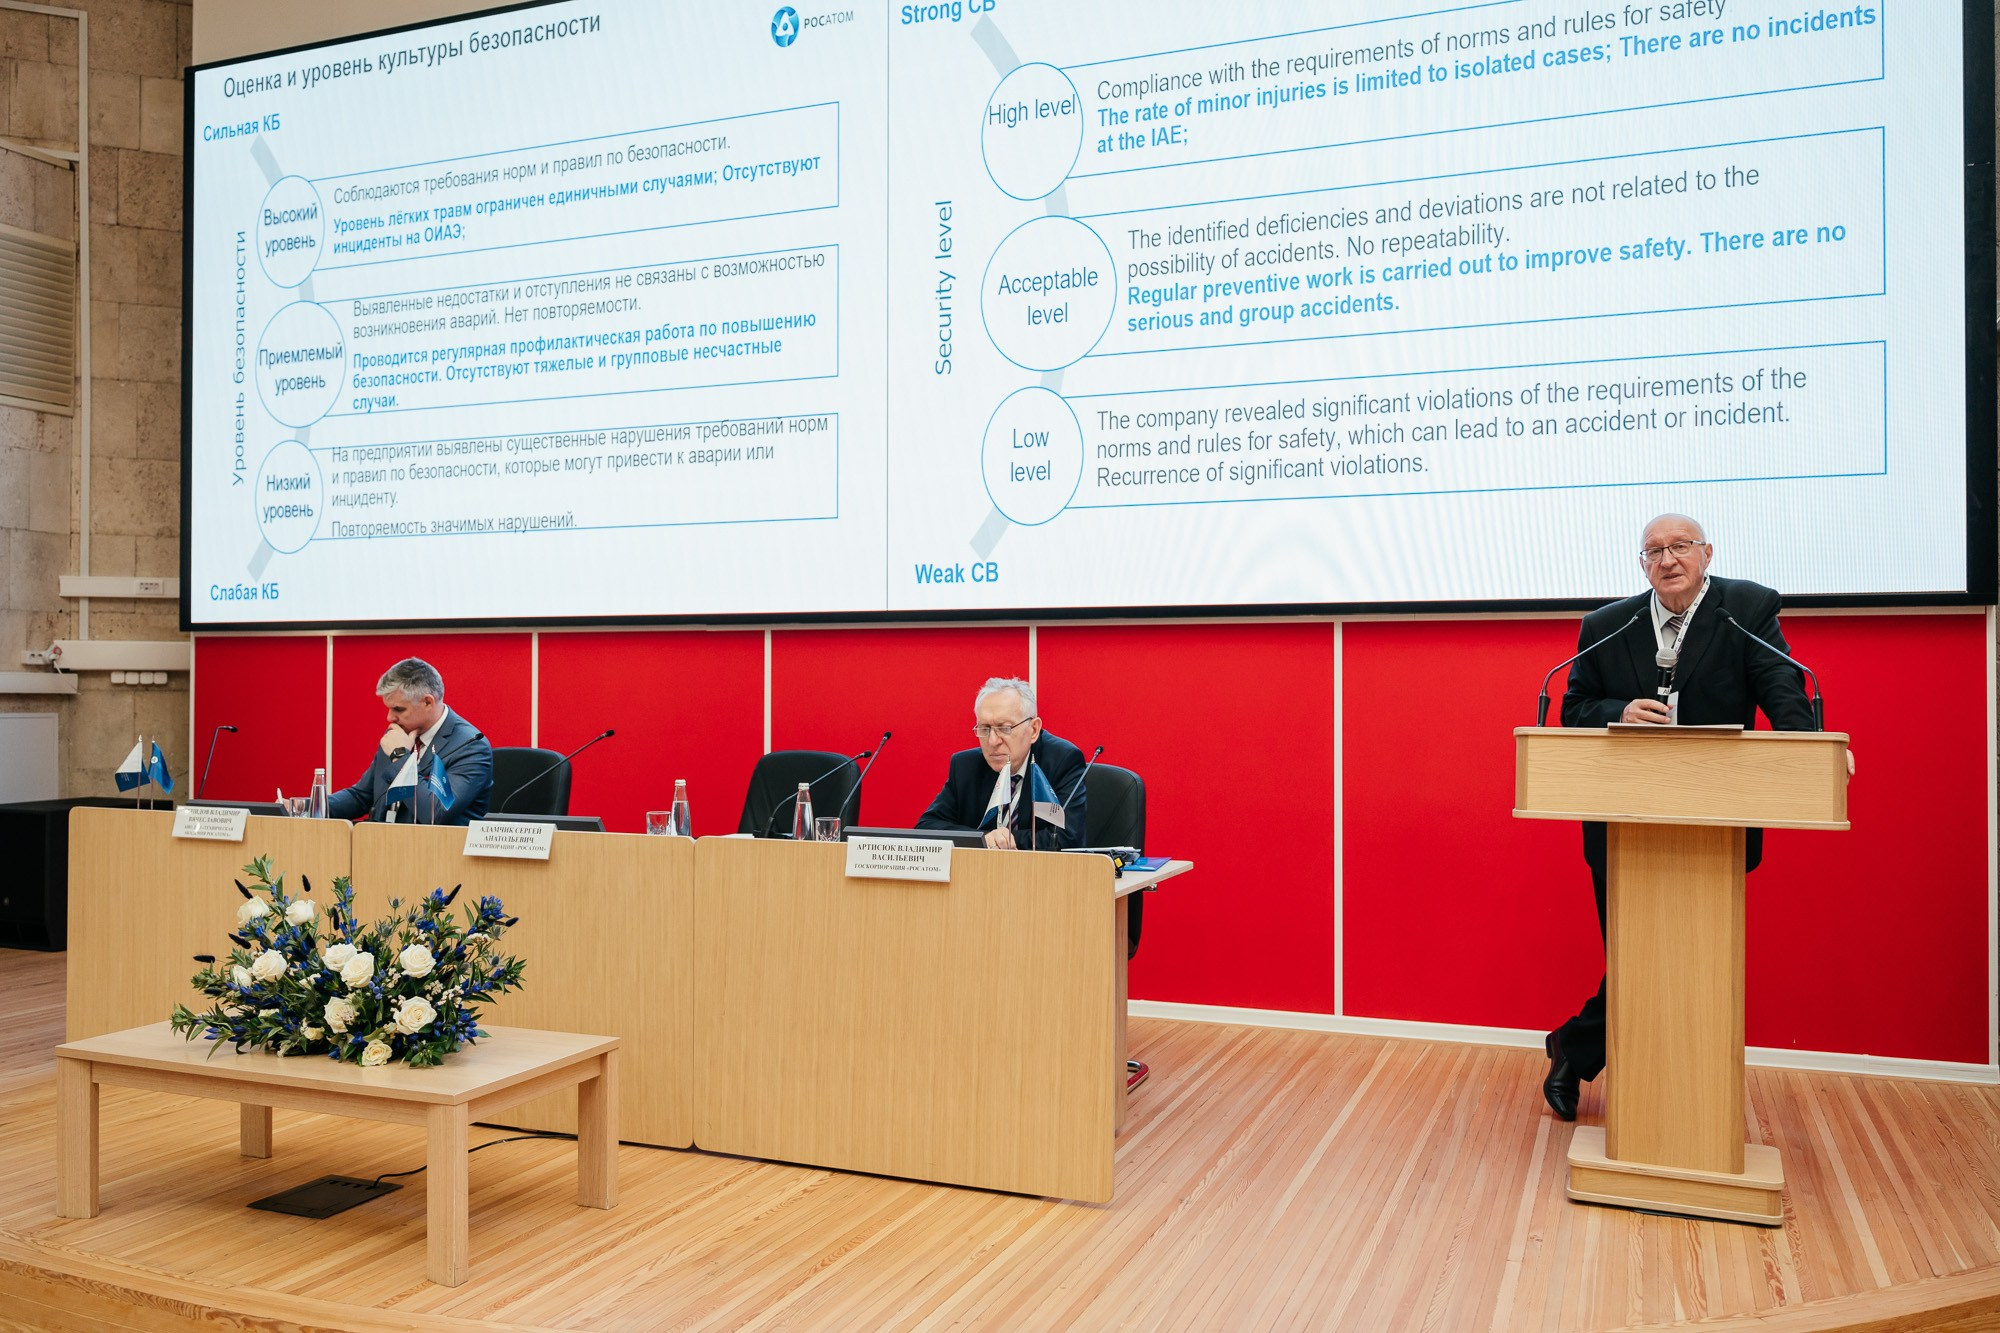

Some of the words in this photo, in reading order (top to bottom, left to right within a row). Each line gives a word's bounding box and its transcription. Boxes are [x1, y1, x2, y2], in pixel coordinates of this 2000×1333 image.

[803, 11, 854, 29] РОСАТОМ
[901, 1, 962, 25] Strong
[968, 0, 996, 14] CB
[223, 73, 282, 98] Оценка
[287, 70, 296, 87] и
[302, 58, 373, 90] уровень
[379, 40, 463, 75] культуры
[469, 15, 600, 54] безопасности
[1097, 72, 1203, 100] Compliance
[1208, 61, 1245, 85] with
[1251, 58, 1280, 79] the
[1287, 39, 1414, 76] requirements
[1421, 31, 1441, 55] of
[1447, 28, 1510, 52] norms
[1517, 15, 1556, 42] and
[1564, 10, 1616, 35] rules
[1623, 4, 1653, 27] for
[1659, 0, 1726, 22] safety
[1097, 107, 1129, 127] The
[1135, 102, 1168, 122] rate
[1174, 96, 1192, 117] of
[1197, 93, 1251, 114] minor
[1257, 81, 1327, 109] injuries
[1333, 76, 1349, 96] is
[1356, 65, 1422, 93] limited
[1428, 64, 1448, 83] to
[1454, 49, 1535, 80] isolated
[1542, 44, 1611, 67] cases;
[1619, 34, 1682, 57] There
[1689, 28, 1724, 48] are
[1732, 24, 1761, 43] no
[1768, 5, 1876, 38] incidents
[988, 101, 1028, 129] High
[1035, 93, 1076, 118] level
[203, 120, 259, 142] Сильная
[263, 113, 281, 132] КБ
[1097, 134, 1114, 154] at
[1118, 131, 1146, 151] the
[1151, 124, 1188, 147] IAE;
[333, 217, 385, 235] Уровень
[388, 210, 429, 226] лёгких
[433, 204, 472, 223] травм
[475, 194, 545, 217] ограничен
[548, 181, 638, 206] единичными
[642, 170, 717, 194] случаями;
[722, 156, 821, 183] Отсутствуют
[1128, 229, 1162, 250] The
[1168, 217, 1249, 246] identified
[1256, 207, 1369, 237] deficiencies
[1375, 200, 1411, 224] and
[1419, 192, 1523, 220] deviations
[1530, 189, 1564, 208] are
[1572, 180, 1605, 204] not
[1612, 171, 1687, 200] related
[1695, 170, 1716, 191] to
[1724, 166, 1760, 188] the
[264, 202, 318, 227] Высокий
[935, 200, 952, 259] level
[265, 235, 316, 257] уровень
[333, 234, 402, 254] инциденты
[406, 232, 420, 245] на
[424, 223, 465, 243] ОИАЭ;
[1128, 251, 1215, 284] possibility
[1221, 247, 1239, 269] of
[1244, 240, 1339, 267] accidents.
[1347, 235, 1375, 257] No
[1381, 223, 1510, 258] repeatability.
[998, 266, 1099, 297] Acceptable
[1128, 282, 1198, 308] Regular
[1203, 273, 1300, 303] preventive
[1306, 266, 1353, 289] work
[1360, 265, 1375, 285] is
[1382, 256, 1452, 282] carried
[1459, 253, 1492, 275] out
[1497, 252, 1519, 272] to
[1525, 246, 1612, 272] improve
[1619, 236, 1692, 261] safety.
[1701, 231, 1765, 253] There
[1772, 228, 1808, 247] are
[1817, 225, 1846, 243] no
[232, 231, 246, 384] безопасности
[1027, 302, 1068, 326] level
[1127, 311, 1194, 332] serious
[1199, 305, 1233, 327] and
[1239, 304, 1295, 328] group
[1300, 292, 1399, 318] accidents.
[935, 271, 957, 375] Security
[259, 342, 343, 369] Приемлемый
[353, 350, 428, 372] Проводится
[431, 343, 506, 365] регулярная
[510, 330, 641, 357] профилактическая
[645, 323, 695, 346] работа
[699, 323, 717, 337] по
[721, 313, 817, 335] повышению
[353, 370, 441, 389] безопасности.
[446, 362, 530, 383] Отсутствуют
[533, 356, 594, 373] тяжелые
[598, 355, 607, 368] и
[611, 348, 689, 370] групповые
[693, 339, 782, 360] несчастные
[275, 375, 326, 396] уровень
[1097, 410, 1130, 431] The
[1136, 409, 1219, 432] company
[1225, 397, 1305, 423] revealed
[1312, 392, 1411, 423] significant
[1416, 387, 1513, 412] violations
[1520, 382, 1540, 405] of
[1546, 381, 1580, 404] the
[1587, 372, 1734, 405] requirements
[1741, 369, 1764, 392] of
[1770, 368, 1807, 390] the
[352, 395, 399, 413] случаи.
[232, 392, 247, 486] Уровень
[1013, 428, 1050, 449] Low
[1097, 441, 1152, 459] norms
[1157, 434, 1190, 456] and
[1197, 432, 1242, 454] rules
[1247, 430, 1273, 451] for
[1278, 427, 1341, 452] safety,
[1348, 422, 1404, 445] which
[1411, 425, 1447, 442] can
[1455, 416, 1498, 440] lead
[1505, 417, 1525, 437] to
[1532, 418, 1557, 436] an
[1565, 408, 1657, 434] accident
[1664, 411, 1687, 429] or
[1695, 401, 1789, 427] incident.
[266, 473, 311, 491] Низкий
[1010, 460, 1051, 482] level
[1097, 467, 1200, 487] Recurrence
[1206, 461, 1224, 482] of
[1229, 457, 1324, 486] significant
[1330, 454, 1428, 476] violations.
[263, 504, 314, 523] уровень
[915, 563, 965, 584] Weak
[971, 561, 999, 583] CB
[210, 583, 258, 601] Слабая
[261, 582, 279, 600] КБ
[485, 835, 534, 843] АНАТОЛЬЕВИЧ
[515, 827, 542, 835] СЕРГЕЙ
[857, 843, 896, 852] АРТИСЮК
[897, 844, 943, 854] ВЛАДИМИР
[871, 853, 926, 863] ВАСИЛЬЕВИЧ
[854, 863, 906, 871] ГОСКОРПОРАЦИЯ
